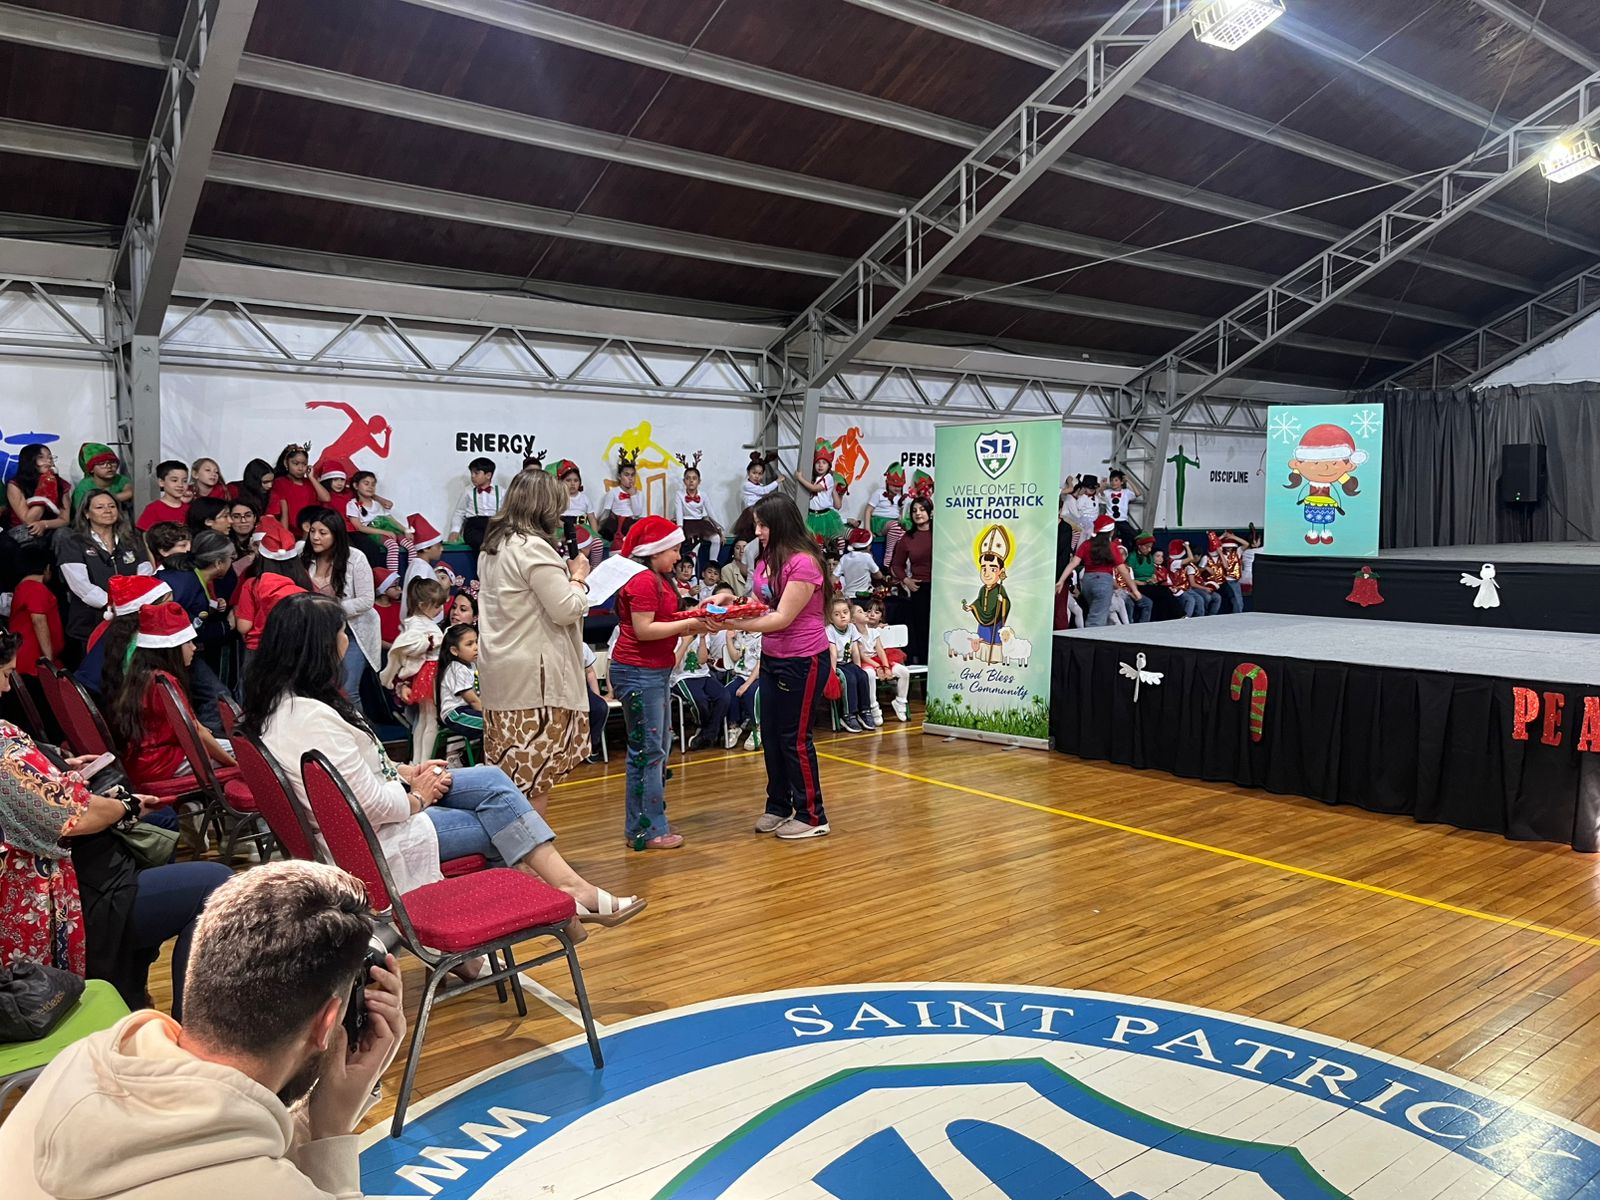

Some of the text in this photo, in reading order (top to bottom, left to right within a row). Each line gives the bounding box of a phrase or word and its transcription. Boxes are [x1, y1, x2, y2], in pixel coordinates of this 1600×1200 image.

[456, 432, 535, 455] ENERGY
[900, 452, 935, 468] PERS
[1210, 470, 1249, 483] DISCIPLINE
[952, 483, 1037, 496] WELCOME TO
[945, 495, 1044, 508] SAINT PATRICK
[966, 508, 1020, 519] SCHOOL
[960, 667, 1015, 684] God Bless
[947, 680, 1029, 701] our Community
[783, 1000, 1075, 1038] SAINT
[1102, 1014, 1582, 1186] PATRICK
